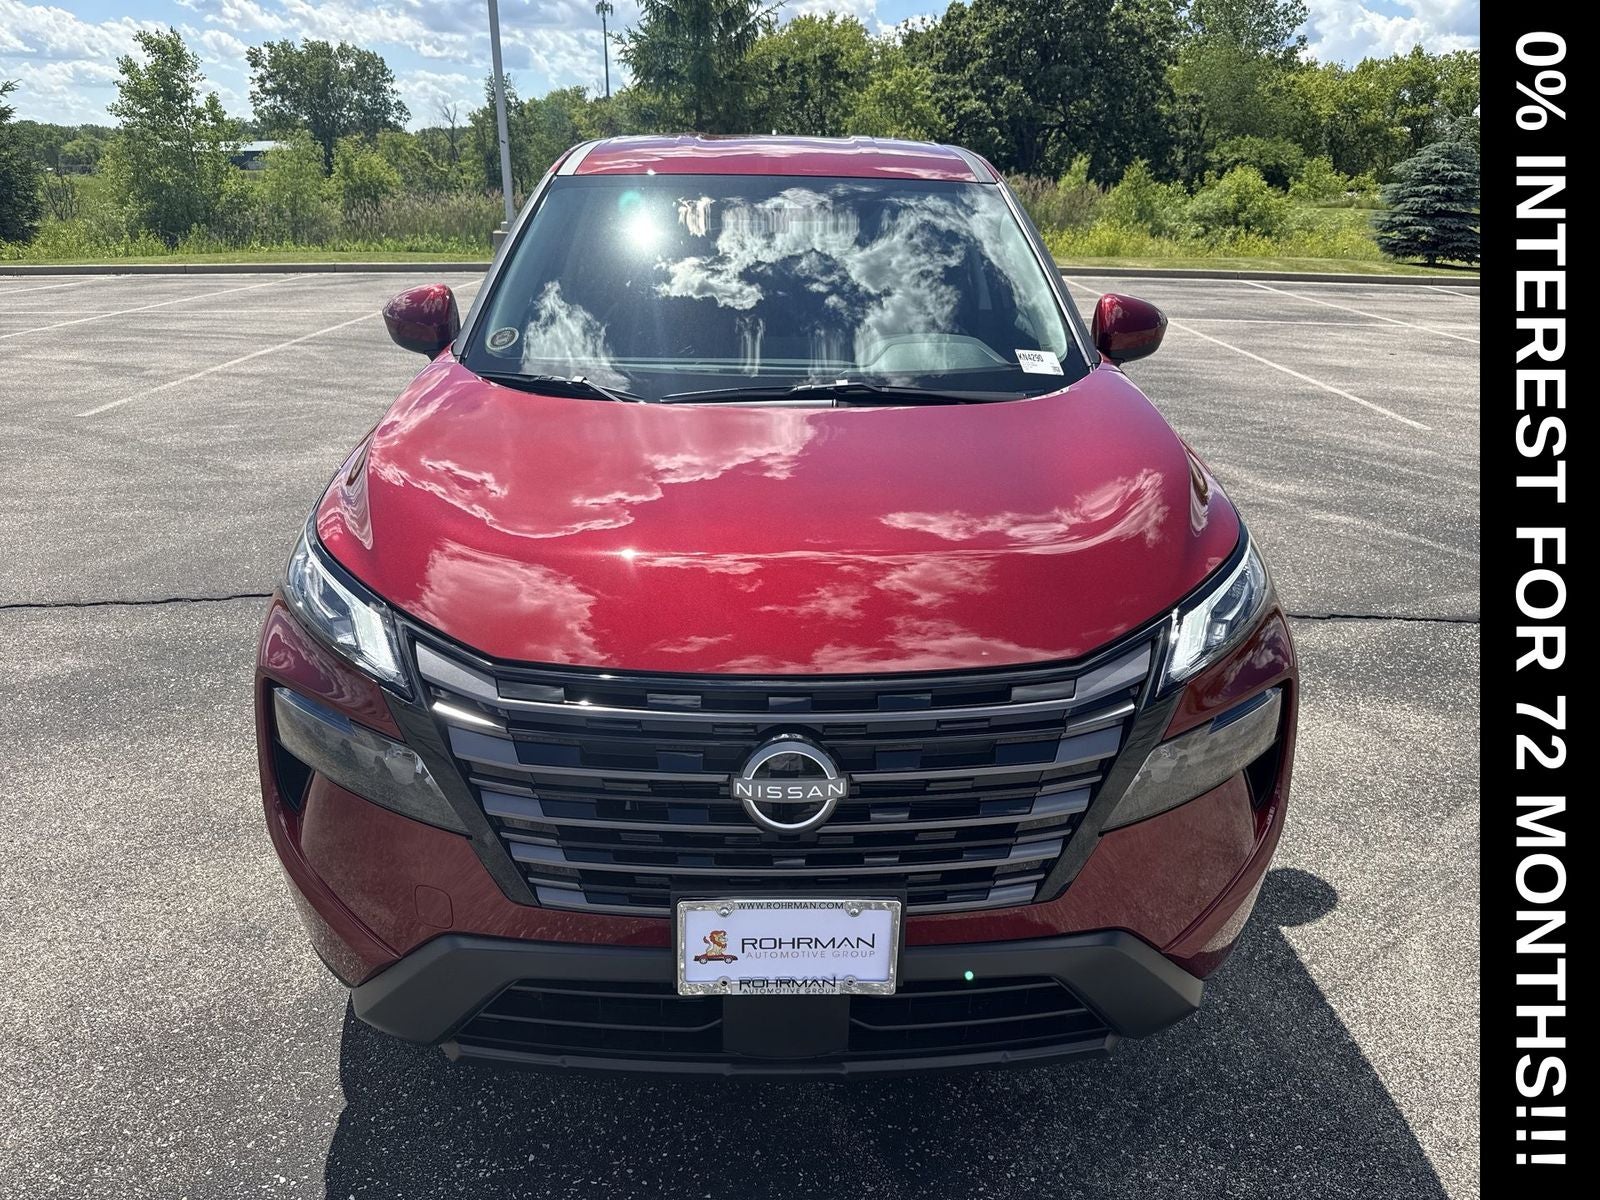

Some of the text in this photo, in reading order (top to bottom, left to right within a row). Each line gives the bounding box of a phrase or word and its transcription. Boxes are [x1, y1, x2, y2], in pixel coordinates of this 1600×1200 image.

[736, 782, 844, 799] NISSAN
[737, 901, 844, 910] WWW.ROHRMAN.COM
[741, 933, 875, 954] ROHRMAN
[746, 950, 875, 959] AUTOMOTIVE GROUP
[738, 975, 836, 991] ROHRMAN
[804, 986, 837, 994] GROUP
